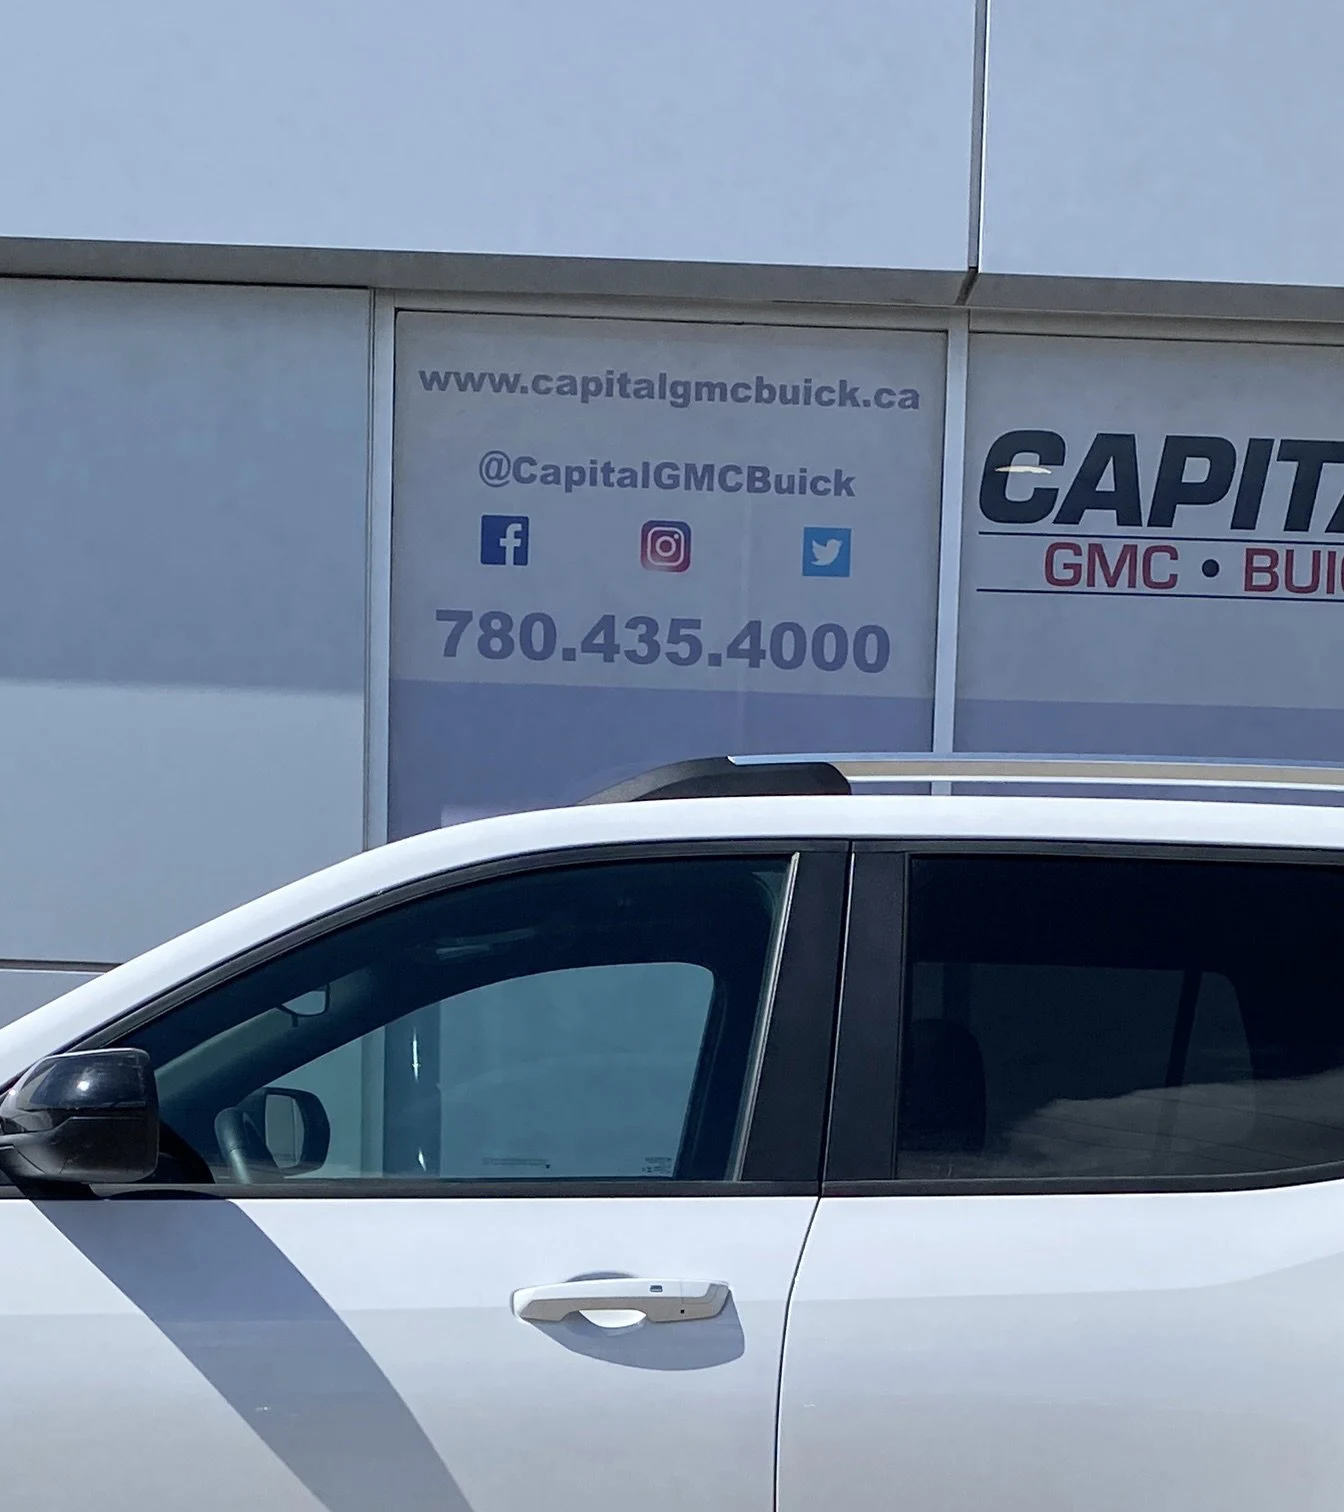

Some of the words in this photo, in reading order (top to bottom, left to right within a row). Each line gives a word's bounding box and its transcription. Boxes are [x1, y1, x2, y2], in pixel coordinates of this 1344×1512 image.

[418, 368, 921, 411] www.capitalgmcbuick.ca
[478, 449, 857, 498] @CapitalGMCBuick
[1043, 541, 1180, 590] GMC
[434, 608, 891, 674] 780.435.4000
